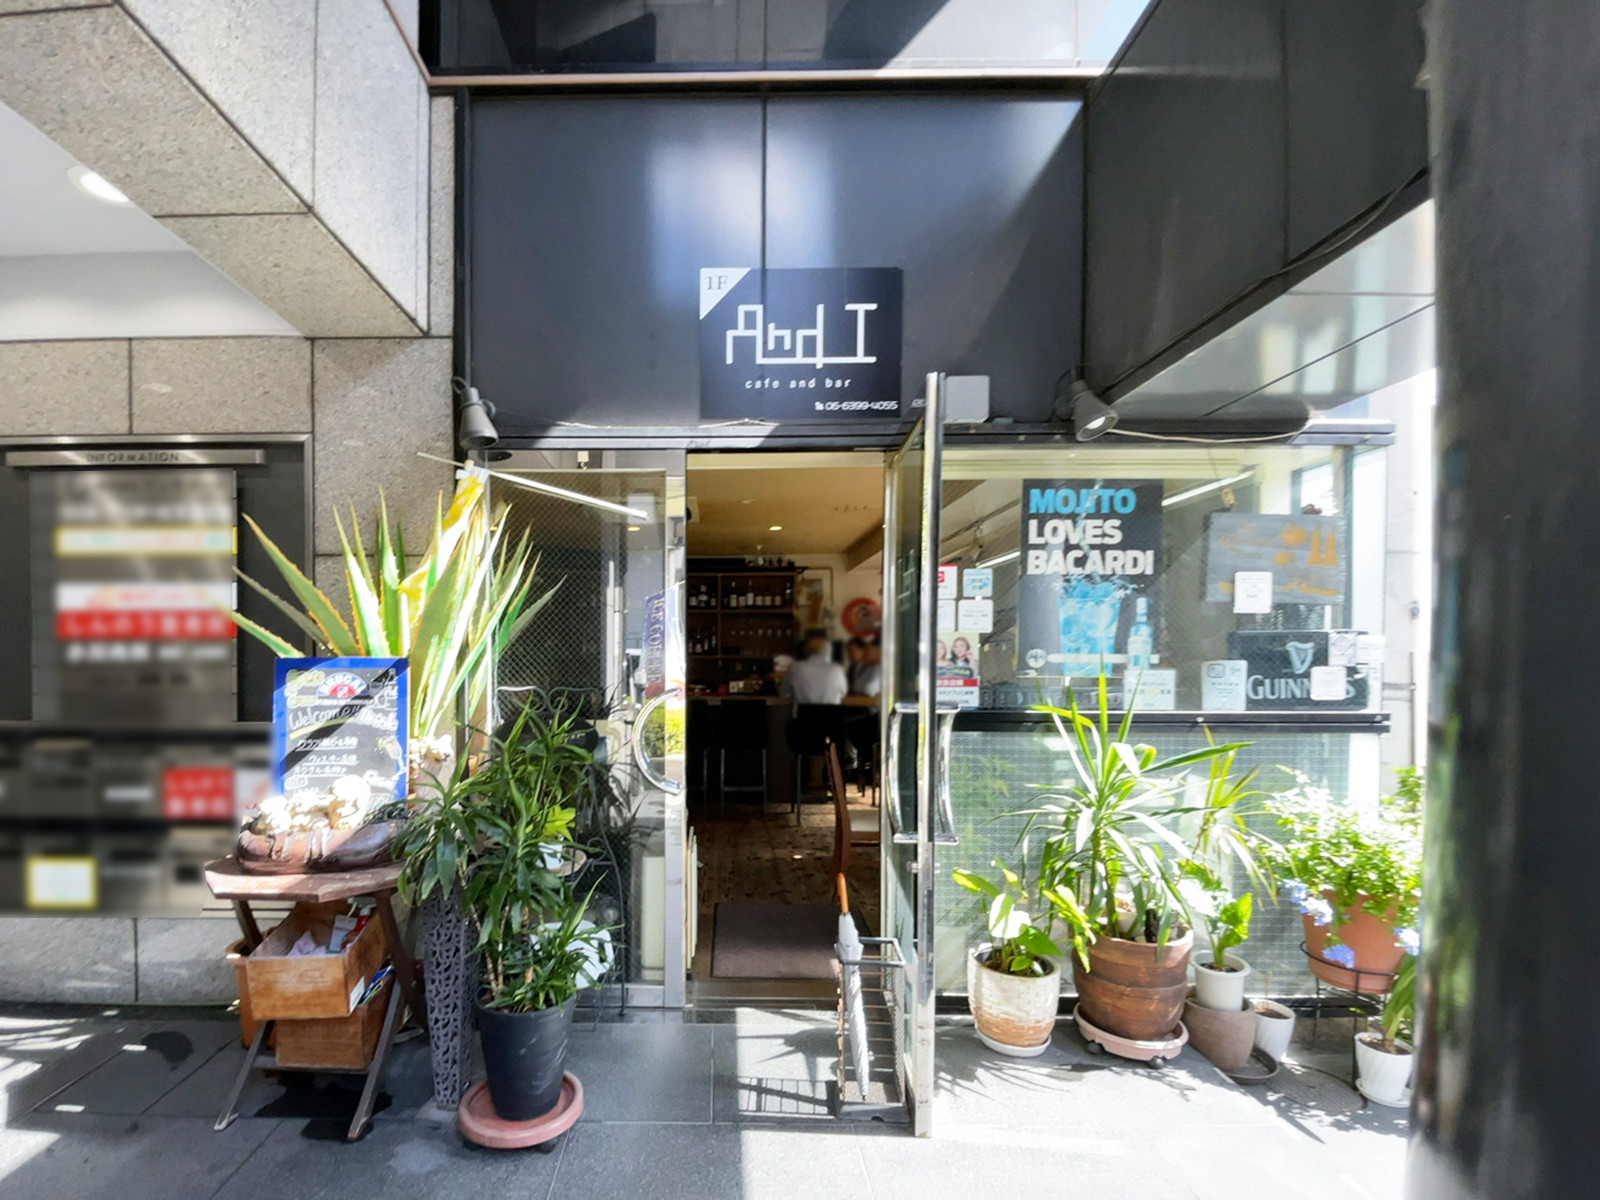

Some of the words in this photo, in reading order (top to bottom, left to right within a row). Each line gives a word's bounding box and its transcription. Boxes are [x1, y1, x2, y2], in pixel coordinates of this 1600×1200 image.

[706, 275, 729, 290] 1F
[744, 377, 780, 389] cafe
[788, 377, 817, 389] and
[824, 377, 852, 389] bar
[86, 452, 180, 463] INFORMATION
[1028, 487, 1137, 515] MOJITO
[1027, 518, 1123, 545] LOVES
[1026, 549, 1155, 576] BACARDI
